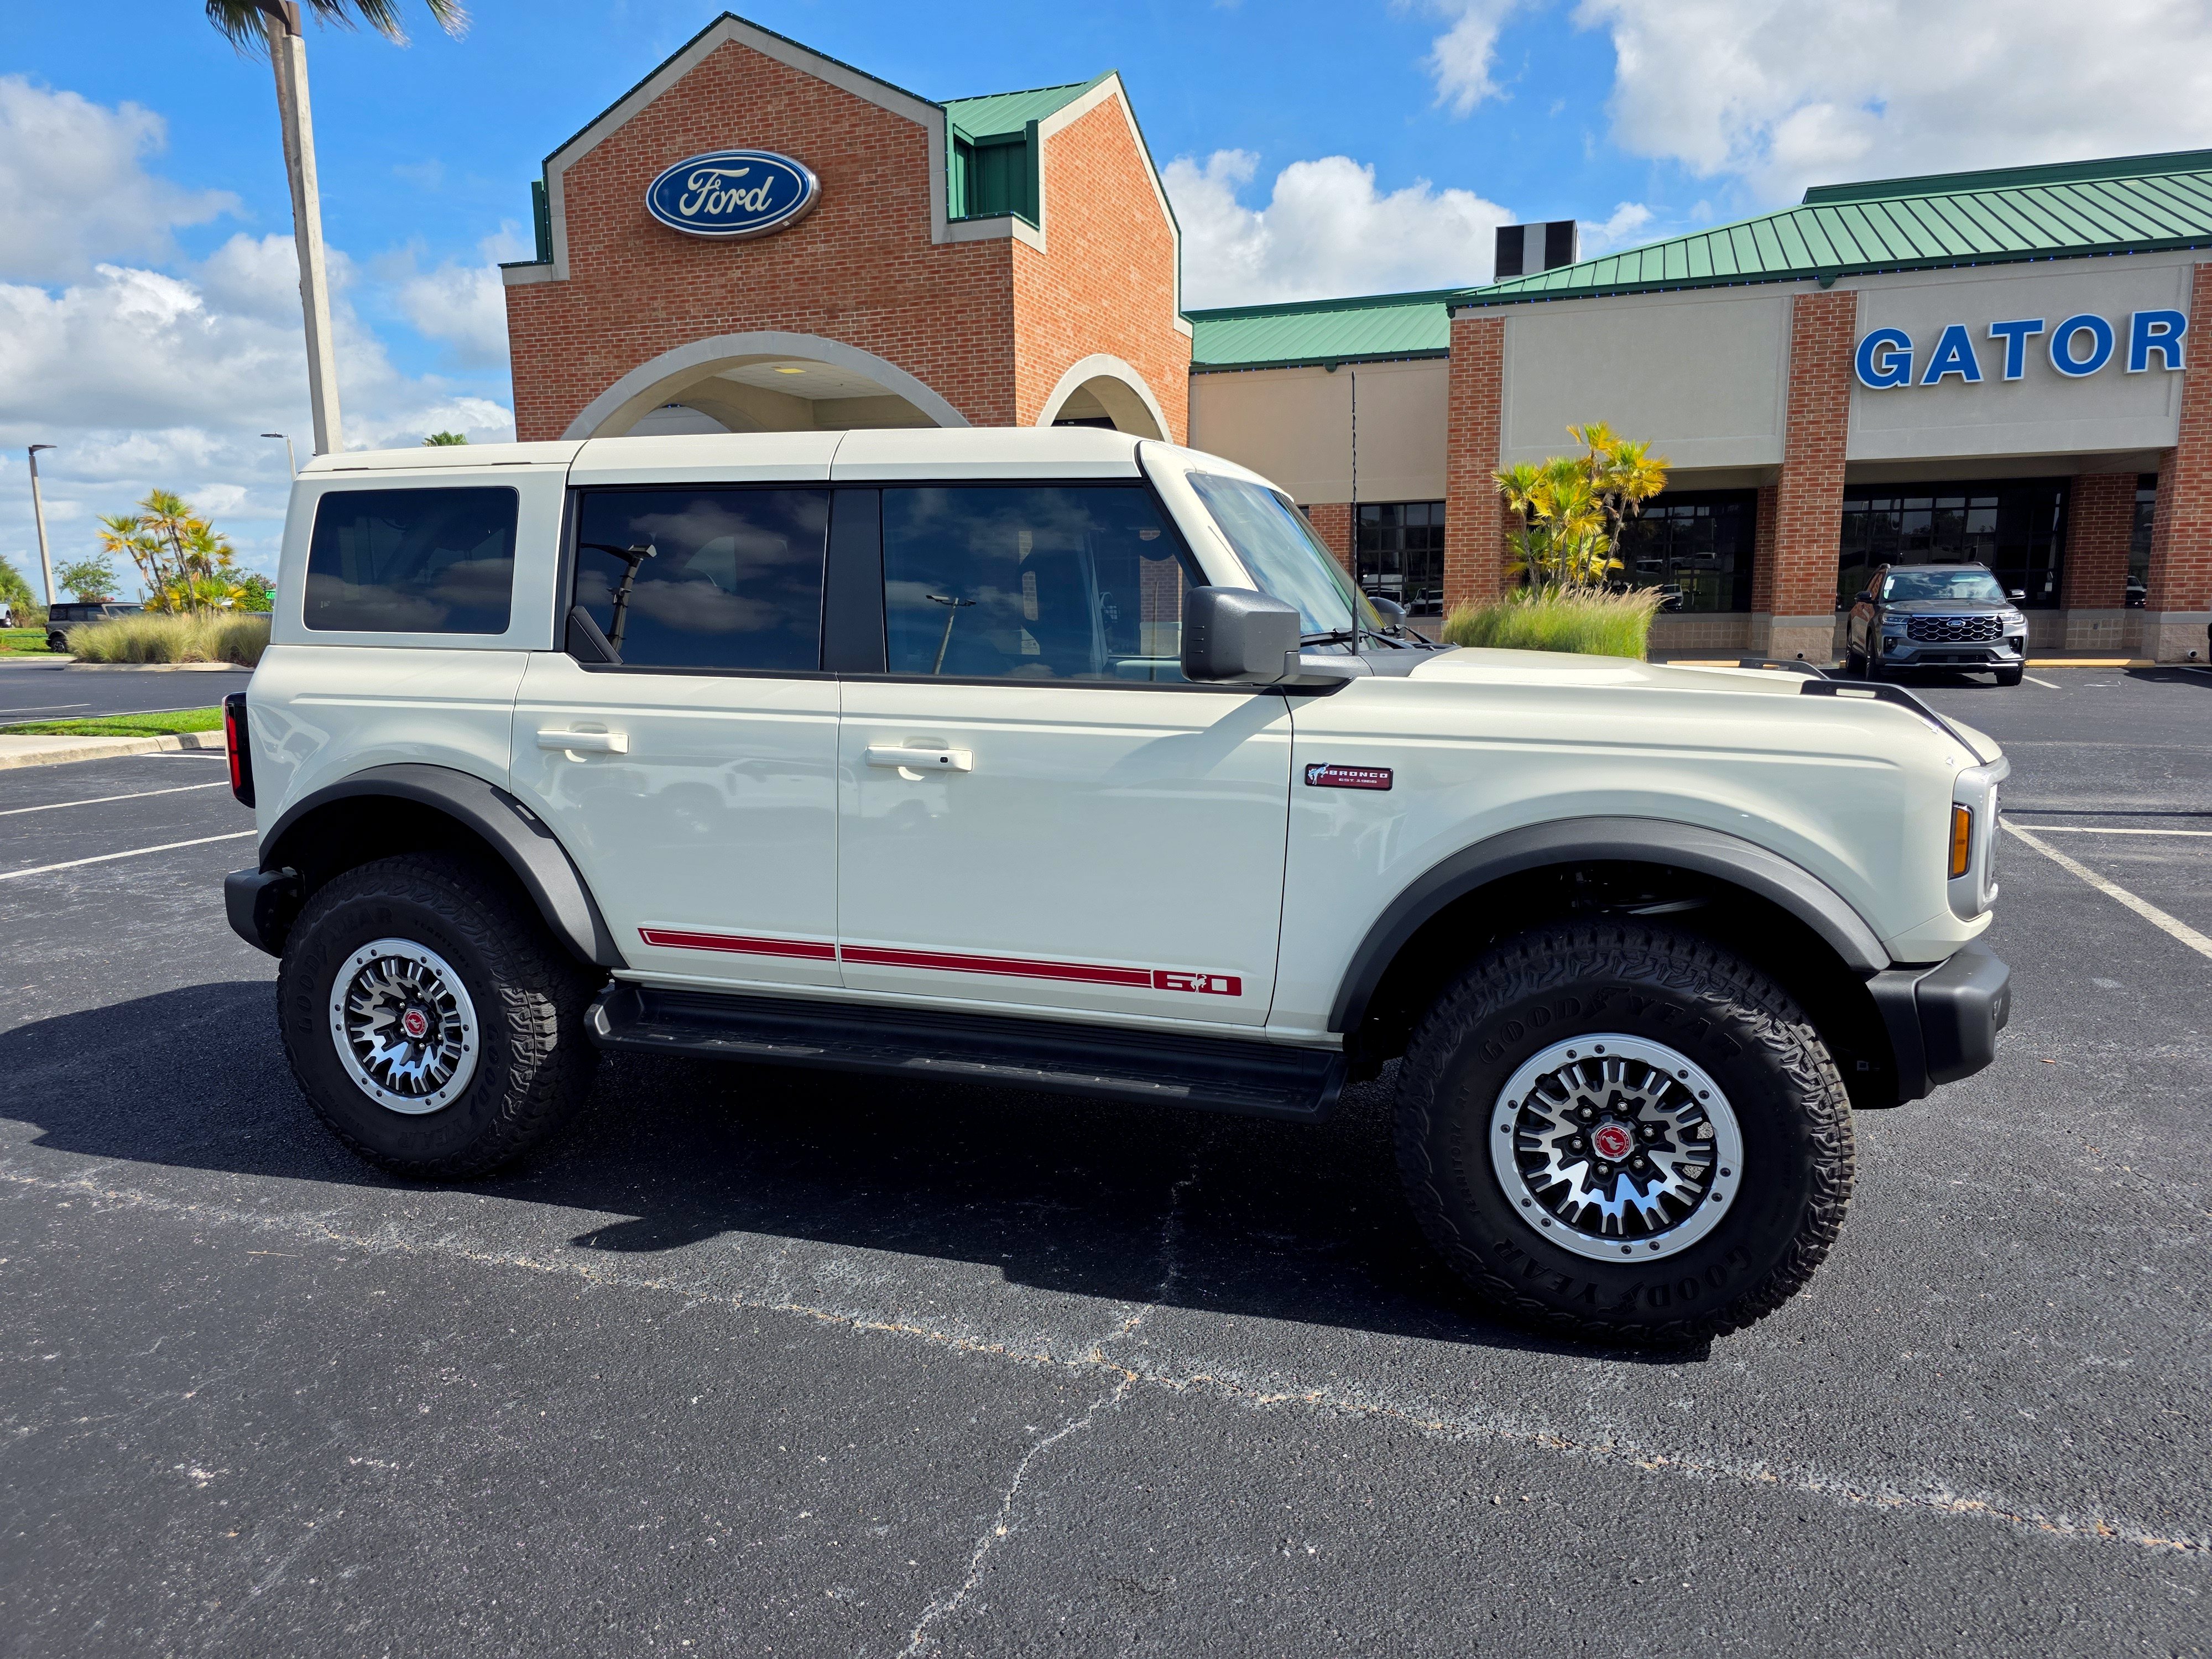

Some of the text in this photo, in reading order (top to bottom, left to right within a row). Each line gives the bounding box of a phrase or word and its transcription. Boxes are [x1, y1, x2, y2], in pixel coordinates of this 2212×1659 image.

[679, 167, 774, 216] Ford
[1855, 309, 2188, 389] GATOR
[1153, 970, 1242, 997] 60
